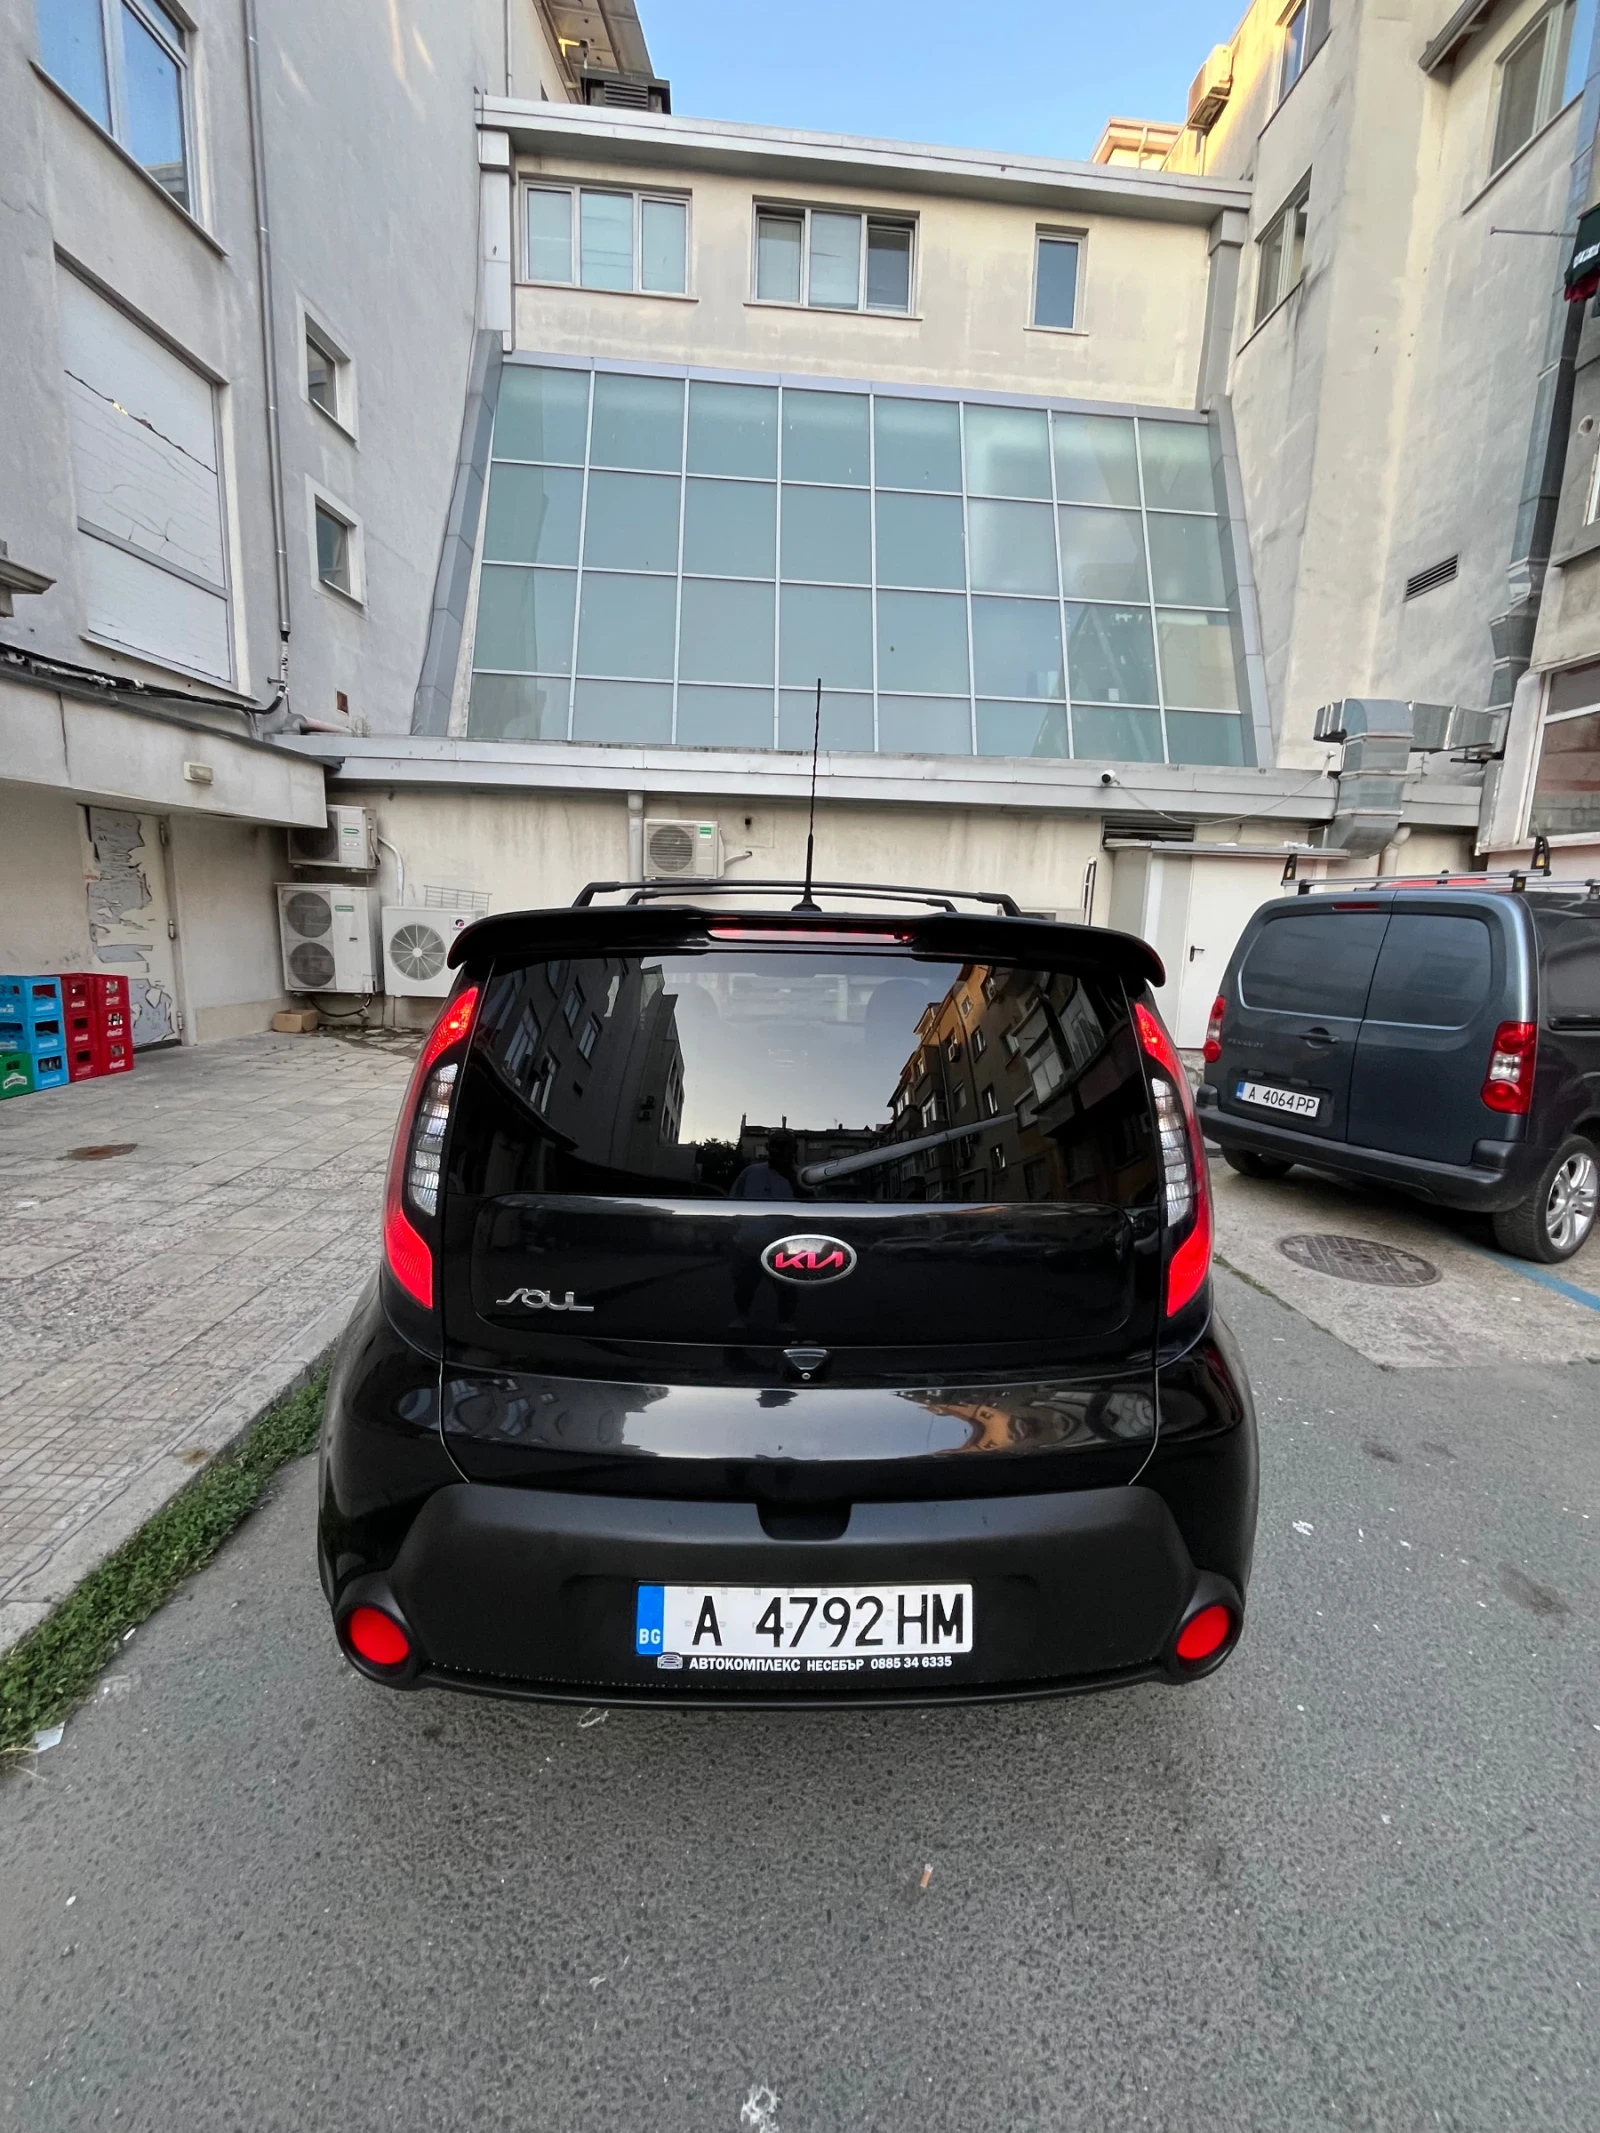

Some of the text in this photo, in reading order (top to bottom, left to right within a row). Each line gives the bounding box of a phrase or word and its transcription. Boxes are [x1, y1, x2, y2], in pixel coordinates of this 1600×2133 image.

[1248, 1086, 1256, 1100] A
[775, 1250, 844, 1270] KIA
[495, 1287, 595, 1312] SOUL
[691, 1595, 723, 1647] A
[755, 1595, 885, 1648] 4792
[639, 1628, 661, 1644] BG
[689, 1655, 953, 1672] АВТОКОМПЛЕКС НЕСЕБЪР 0885 34 6335
